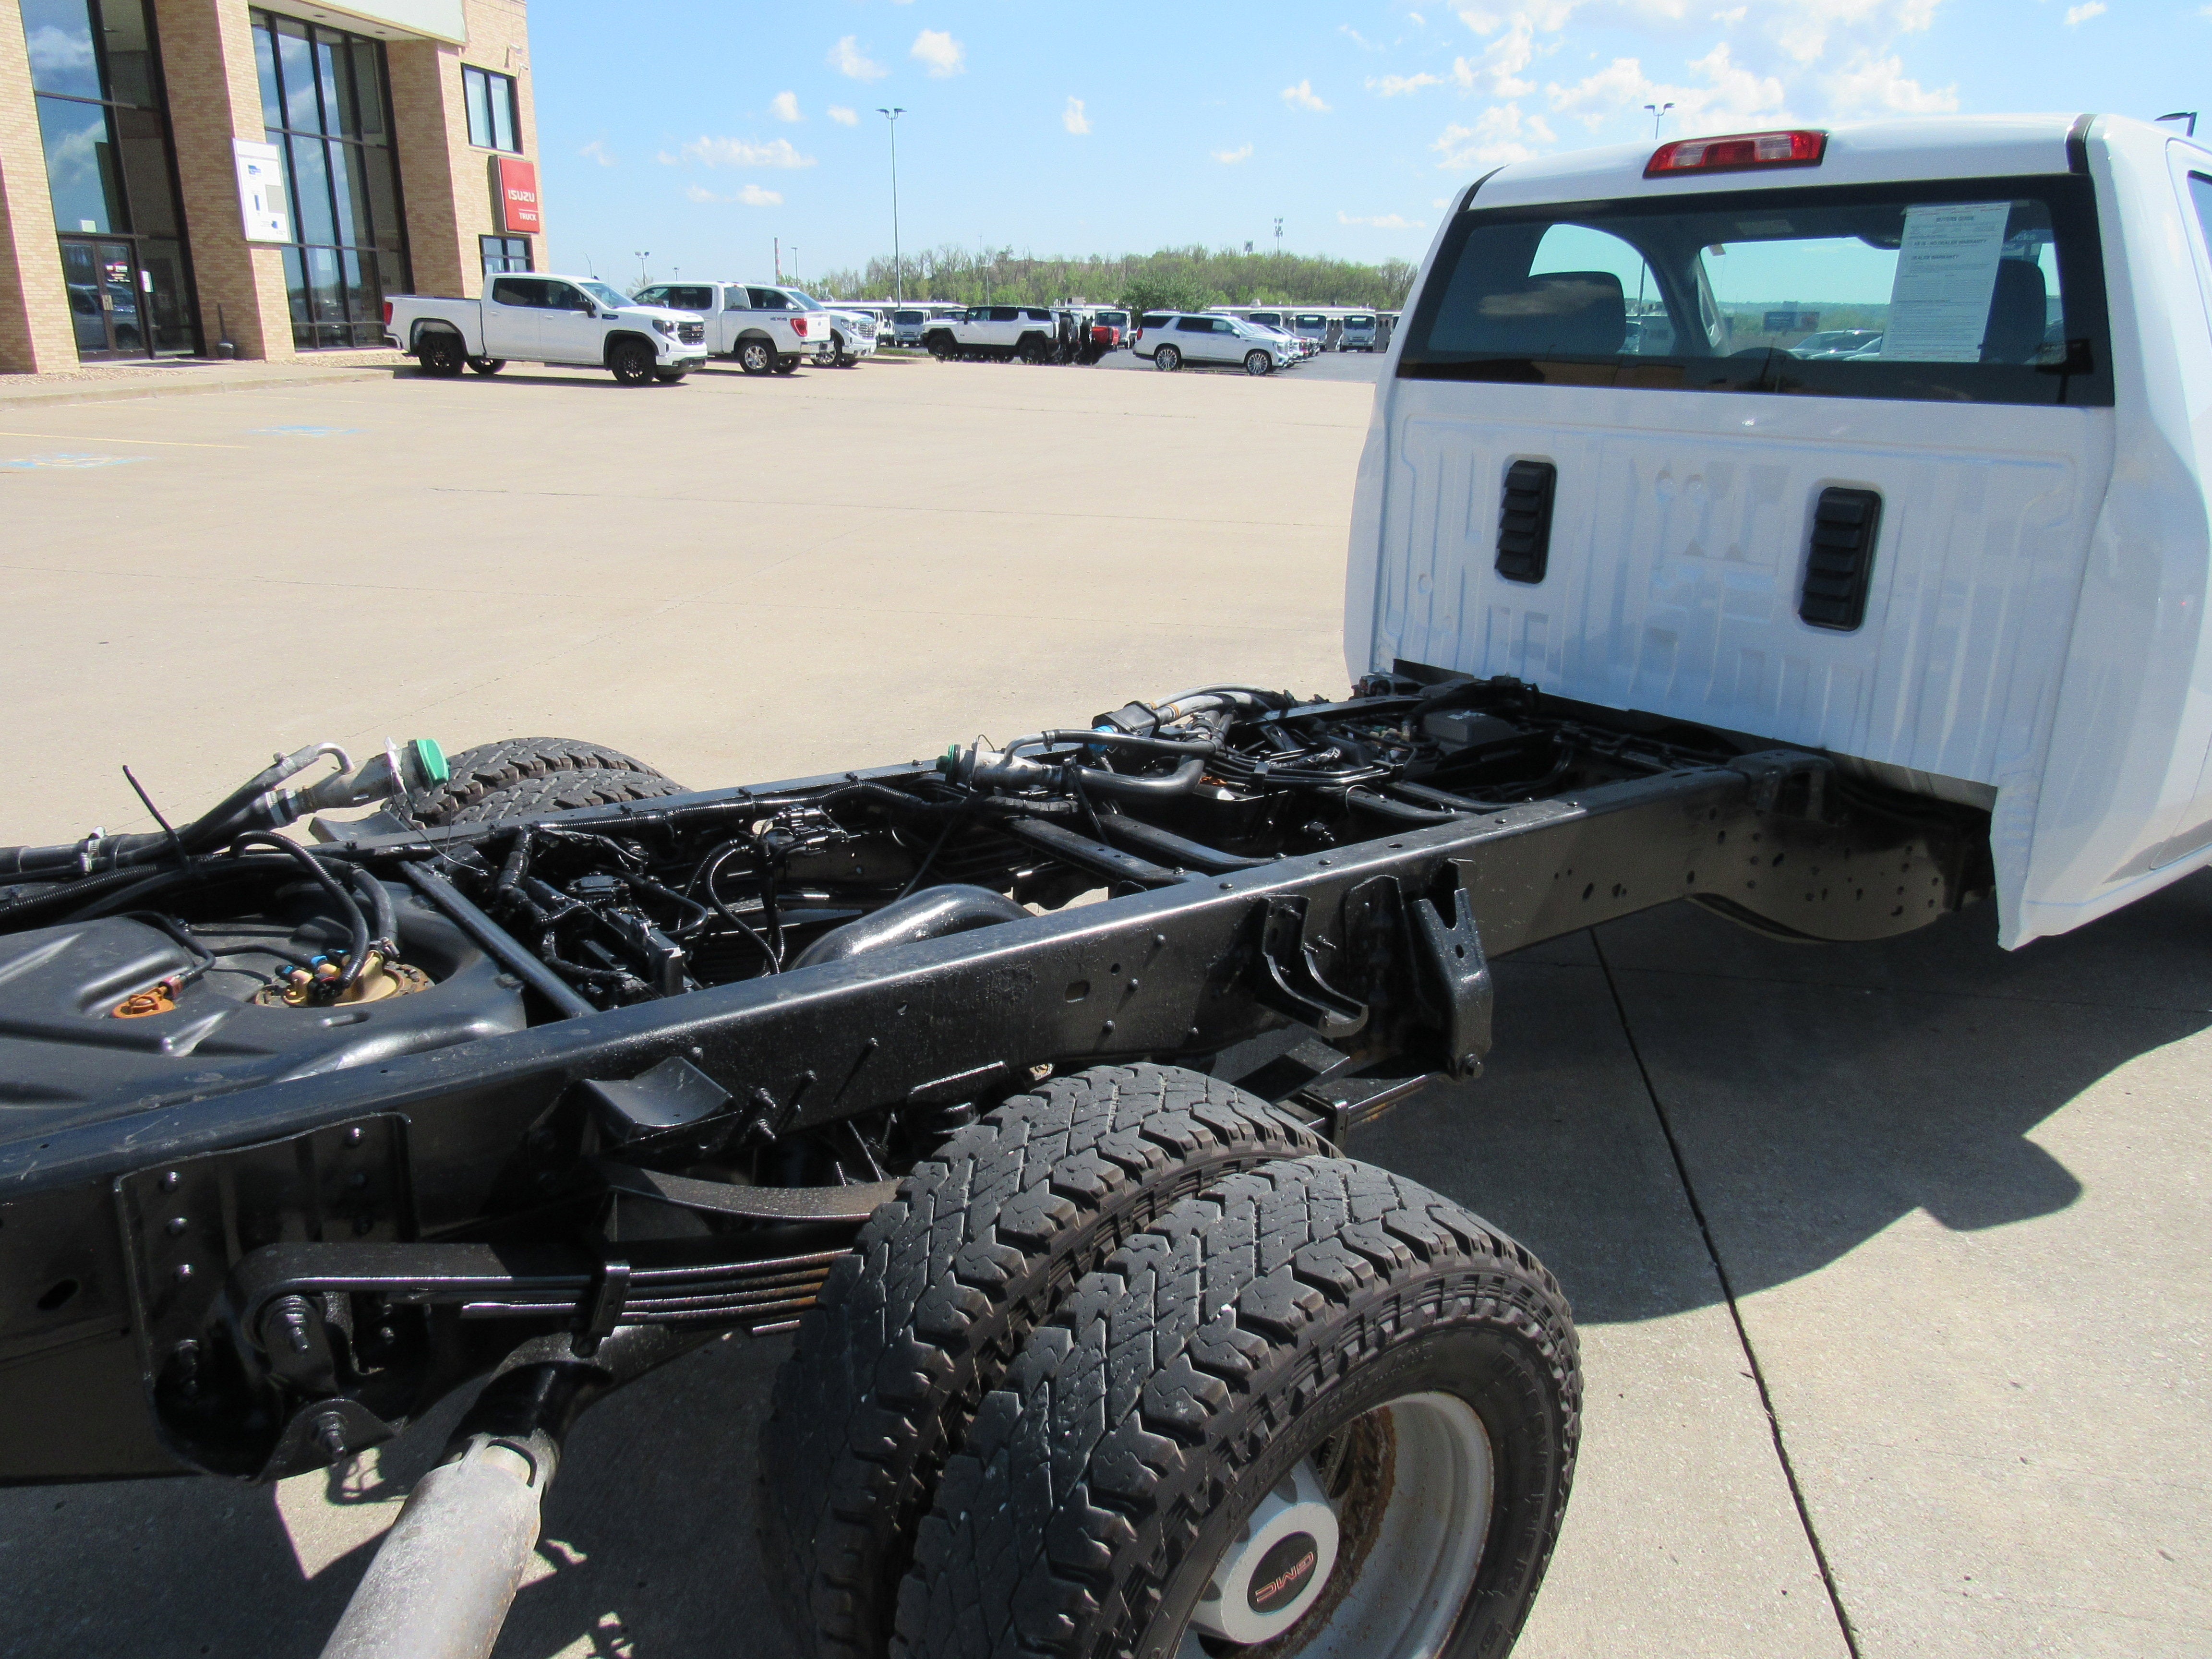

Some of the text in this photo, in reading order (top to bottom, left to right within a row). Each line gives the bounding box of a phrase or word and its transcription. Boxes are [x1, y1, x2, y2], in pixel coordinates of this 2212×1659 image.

[507, 189, 535, 203] ISUZU
[518, 212, 537, 221] TRUCK
[1254, 1551, 1314, 1602] GMC
